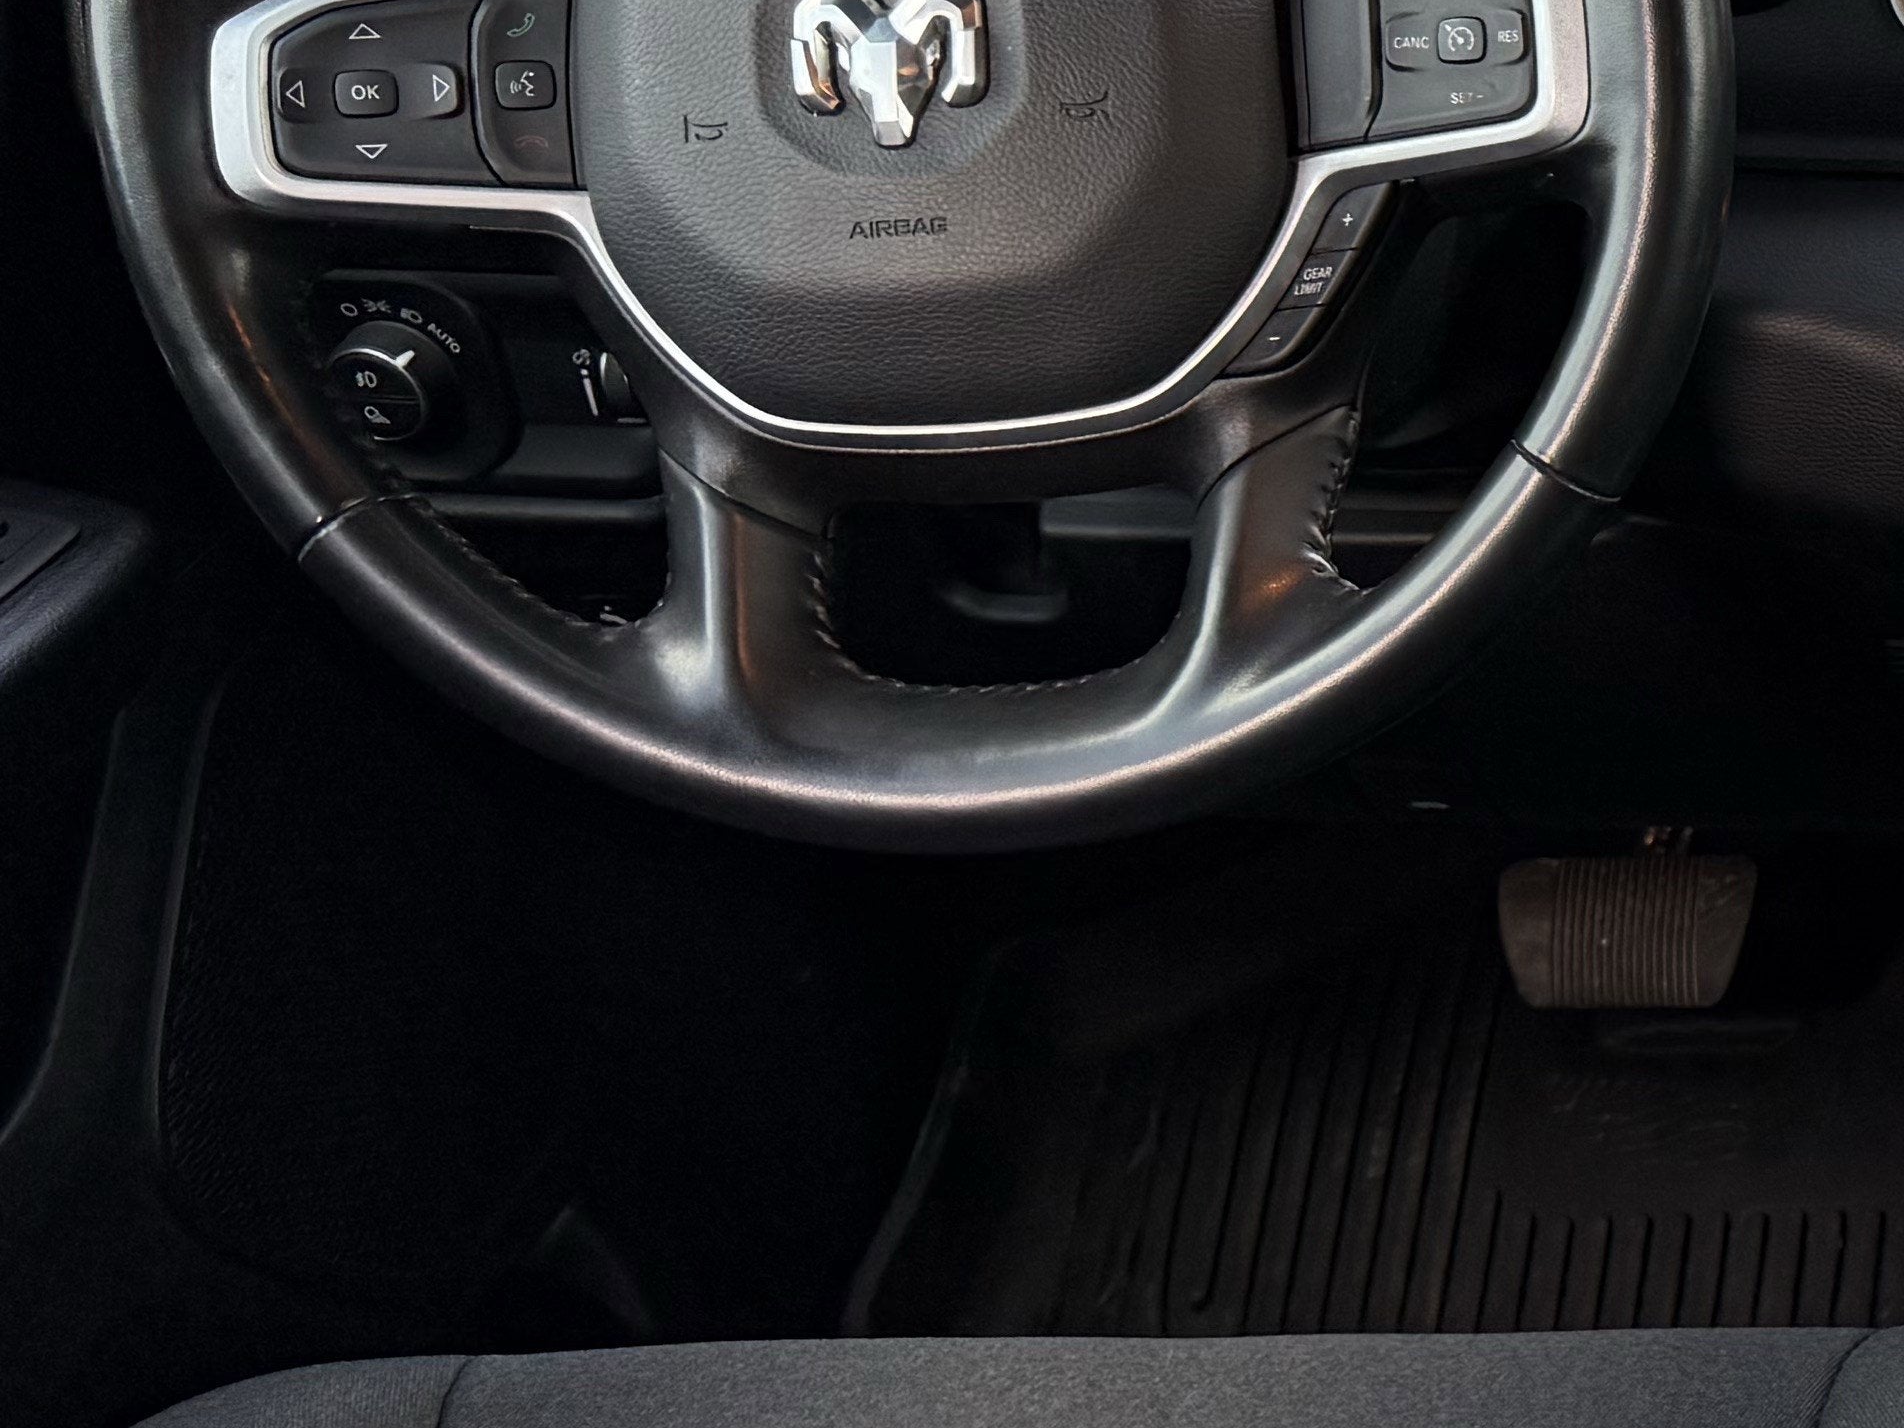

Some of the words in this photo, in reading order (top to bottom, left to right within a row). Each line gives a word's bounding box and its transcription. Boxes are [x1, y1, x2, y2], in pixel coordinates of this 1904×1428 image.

[1393, 37, 1430, 50] CANC
[1497, 30, 1520, 43] RES
[350, 84, 380, 100] OK
[849, 216, 949, 241] AIRBAG
[1303, 266, 1333, 280] GEAR
[1294, 281, 1324, 296] LIMIT
[426, 322, 462, 356] AUTO
